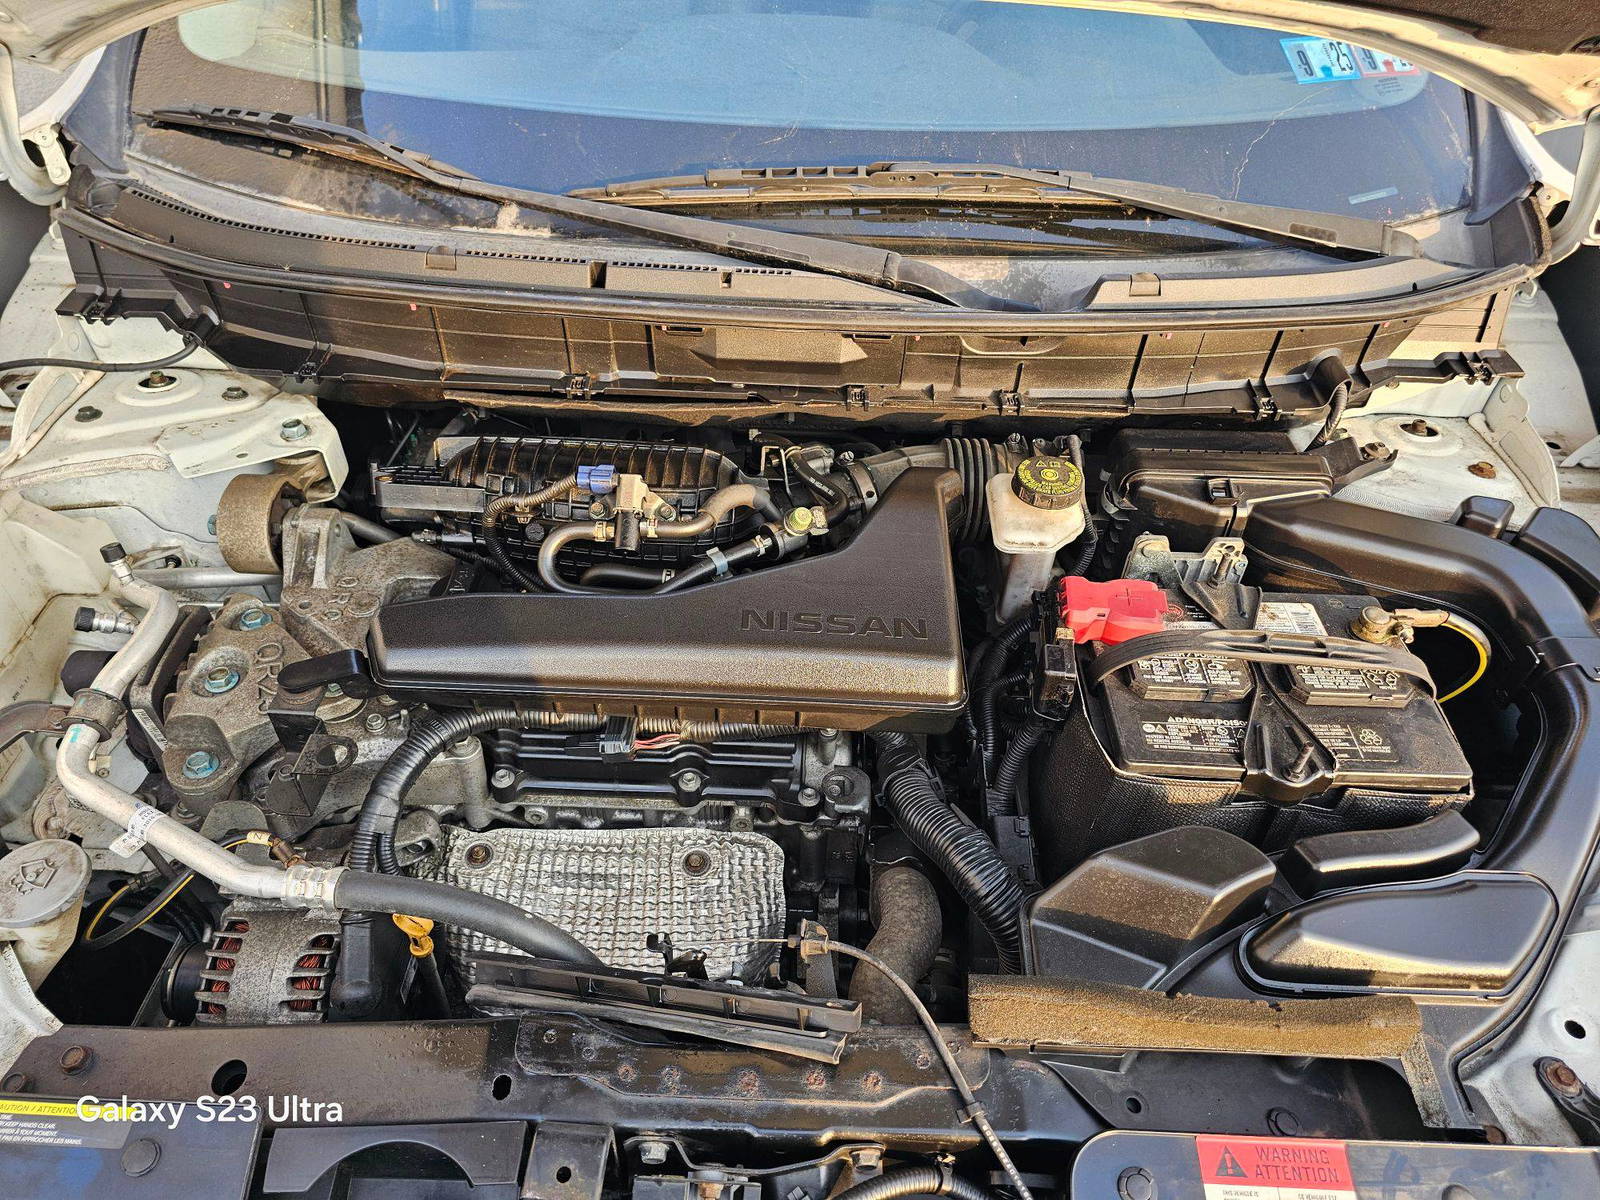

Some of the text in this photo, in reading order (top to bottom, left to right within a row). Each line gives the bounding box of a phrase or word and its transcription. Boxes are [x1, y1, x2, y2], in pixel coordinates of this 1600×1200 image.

[1329, 41, 1354, 72] 25
[741, 608, 929, 640] NISSAN
[0, 1103, 30, 1111] AUTION
[37, 1105, 78, 1114] ATTENTIO
[1255, 1145, 1330, 1165] WARNING
[1255, 1164, 1340, 1183] ATTENTION
